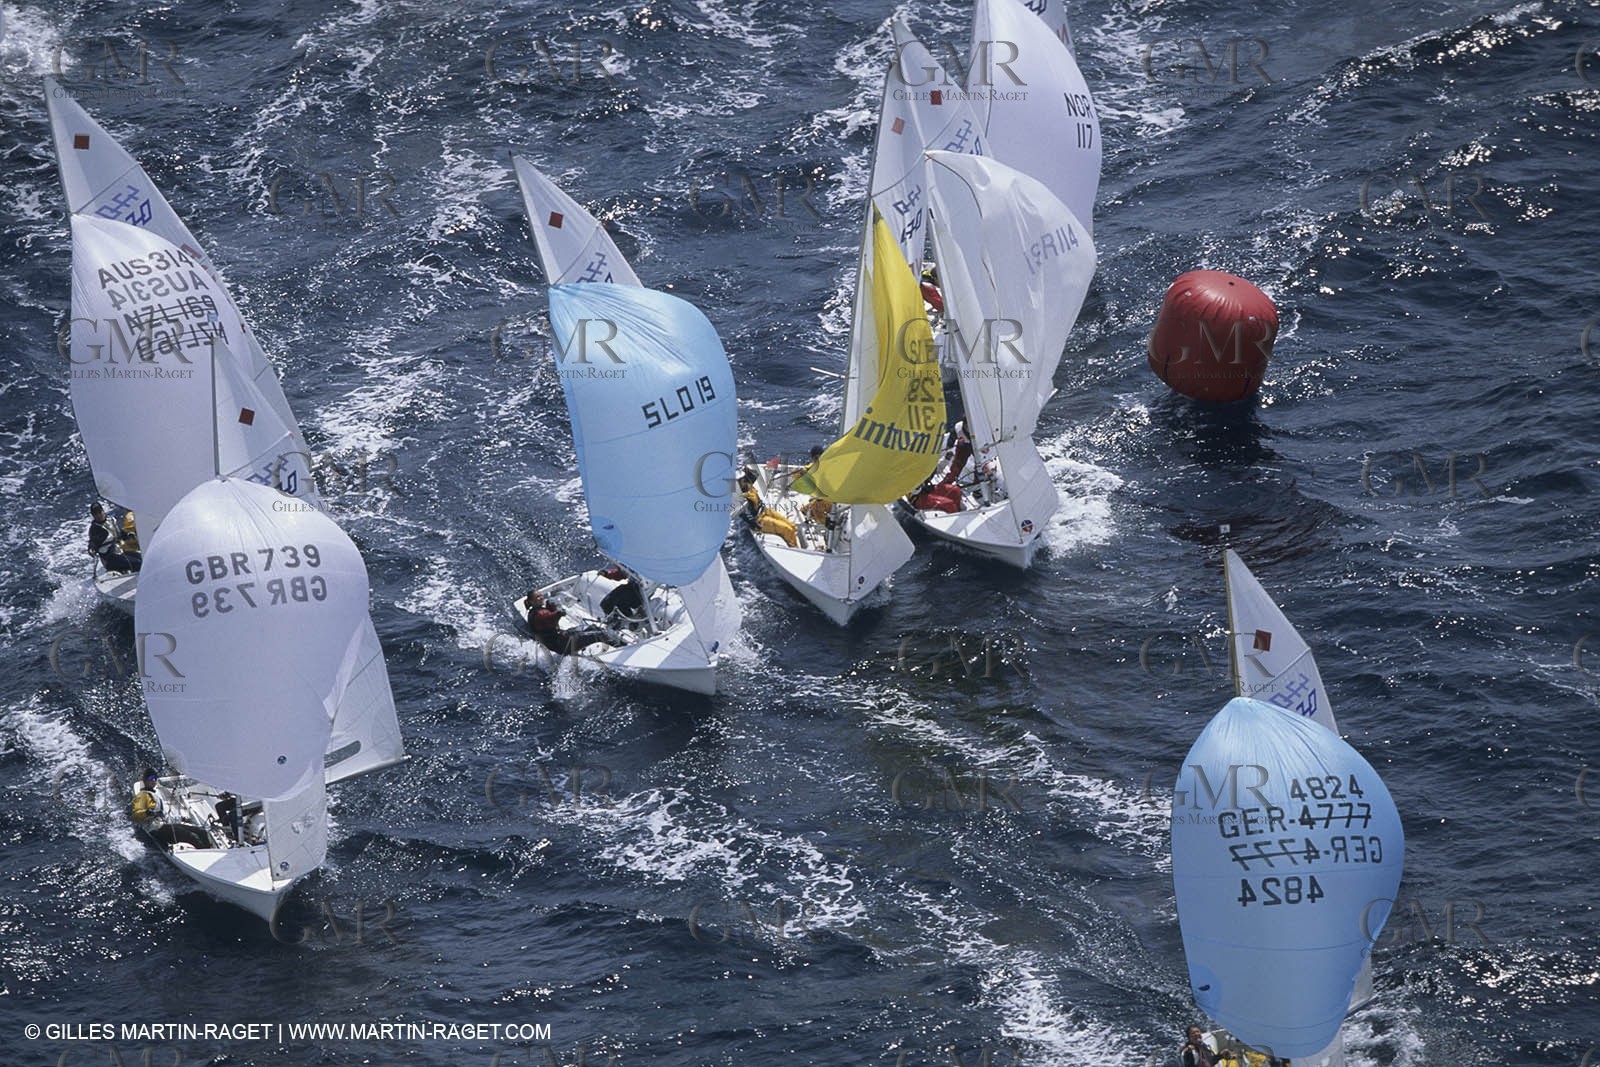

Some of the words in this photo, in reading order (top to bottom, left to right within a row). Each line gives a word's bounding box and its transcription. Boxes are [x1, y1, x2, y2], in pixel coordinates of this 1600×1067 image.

[1064, 92, 1094, 119] NOR
[1077, 122, 1093, 149] 117
[98, 249, 194, 289] AUS314
[853, 407, 932, 455] intrum
[185, 552, 252, 585] GBR
[257, 544, 321, 572] 739
[1290, 774, 1364, 802] 4824
